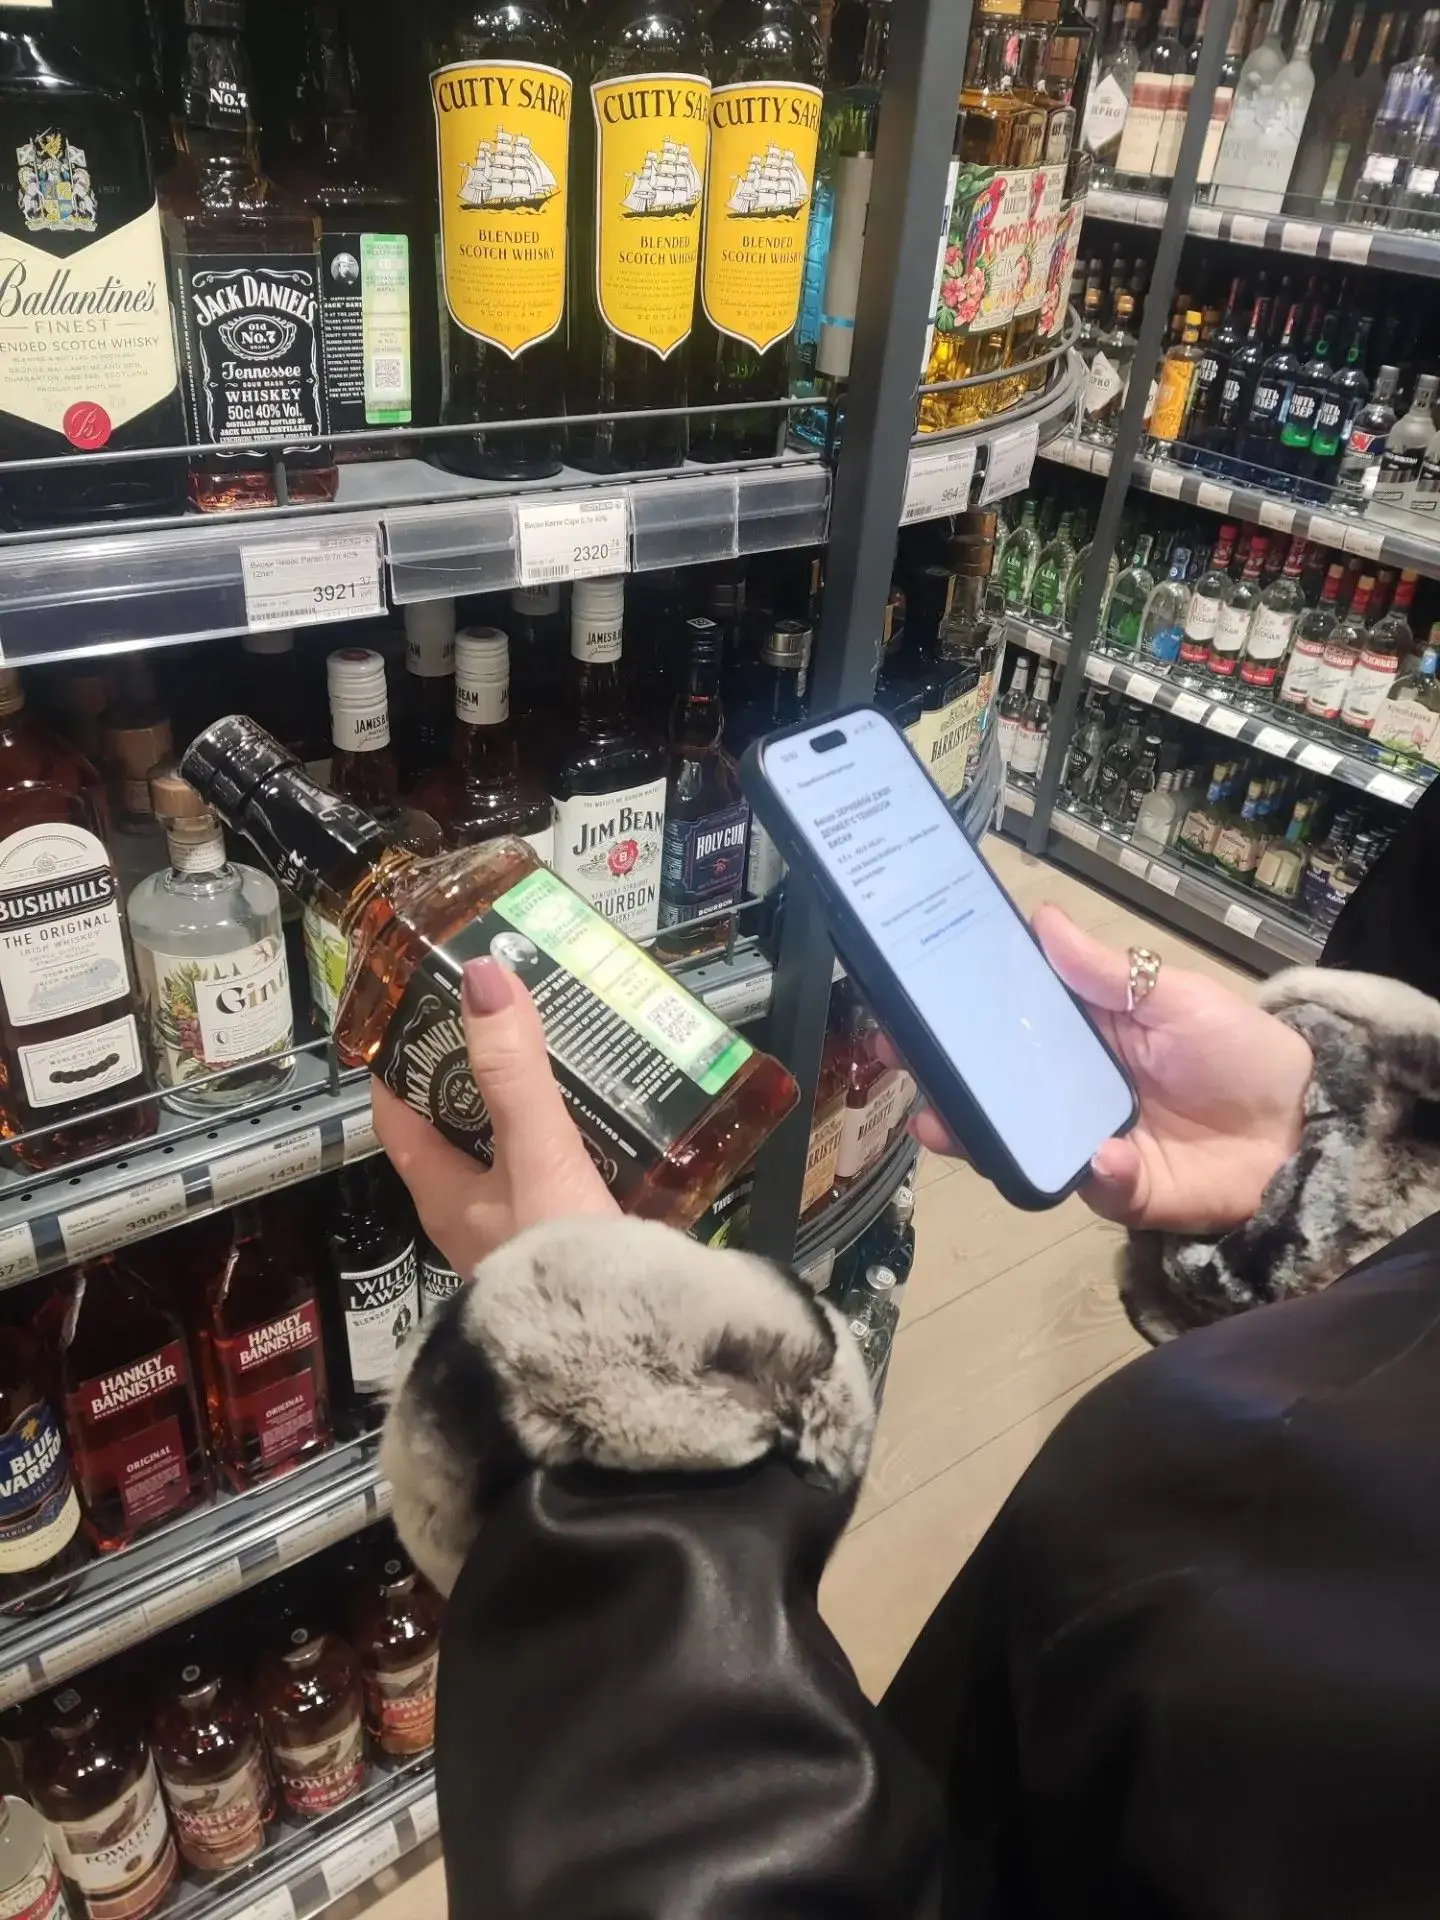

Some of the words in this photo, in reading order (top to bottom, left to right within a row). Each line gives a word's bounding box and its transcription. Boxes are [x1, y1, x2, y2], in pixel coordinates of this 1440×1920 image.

[218, 81, 237, 91] Old
[209, 88, 248, 108] No.7
[437, 77, 514, 113] CUTTY
[518, 77, 568, 121] SARK
[602, 90, 681, 125] CUTTY
[713, 98, 784, 128] CUTTY
[478, 229, 540, 245] BLENDED
[640, 236, 690, 248] BLENDED
[742, 236, 793, 248] BLENDED
[459, 244, 507, 261] SCOTCH
[512, 247, 555, 261] WHISKY
[619, 251, 664, 264] SCOTCH
[668, 250, 698, 264] WHISK
[721, 250, 767, 263] SCOTCH
[0, 257, 157, 318] Ballantine's
[192, 284, 244, 327] JACK
[243, 276, 318, 323] DANIEL'S
[34, 319, 110, 335] FINEST
[248, 323, 267, 331] Old
[636, 313, 686, 321] SCOTLAN
[0, 340, 48, 353] ENDED
[53, 338, 106, 352] SCOTCH
[110, 336, 160, 348] WHISKY
[240, 331, 277, 345] No.7
[47, 363, 102, 373] BALLANTINE
[221, 361, 301, 380] Tennessee
[225, 388, 302, 403] WHISKEY
[227, 405, 254, 421] 50cl
[256, 404, 281, 418] 40%
[283, 403, 302, 417] Vol.
[220, 428, 239, 436] JACK
[241, 427, 268, 435] DANIEL
[269, 424, 313, 433] DISTILLERY
[225, 420, 255, 428] DISTILLED
[271, 418, 294, 426] BOTTLED
[941, 488, 958, 501] 964
[574, 544, 608, 562] 2320
[312, 582, 356, 603] 3921
[587, 632, 612, 645] JAMES
[354, 714, 381, 734] JAMES
[573, 819, 615, 855] JIM
[696, 832, 723, 860] HOLY
[723, 822, 746, 846] GUN
[0, 874, 112, 921] BUSHMILLS
[698, 899, 733, 916] BOURBON
[4, 930, 33, 949] THE
[40, 912, 111, 942] ORIGINAL
[20, 943, 50, 957] IRISH
[53, 930, 101, 949] WHISKEY
[406, 1067, 434, 1124] JACK
[580, 1104, 620, 1143] QUALITY
[269, 1162, 304, 1181] 1434
[125, 1208, 168, 1232] 3306
[355, 1253, 416, 1295] WILLIA
[423, 1267, 460, 1288] WILLI
[350, 1268, 416, 1310] LAWSO
[248, 1312, 302, 1348] HANKEY
[240, 1320, 313, 1367] BANNISTER
[99, 1354, 162, 1396] HANKEY
[91, 1363, 177, 1415] BANNISTER
[265, 1395, 304, 1418] ORIGINAL
[9, 1426, 52, 1476] BLUE
[126, 1446, 171, 1474] ORIGINAL
[301, 1779, 356, 1804] CHERRY
